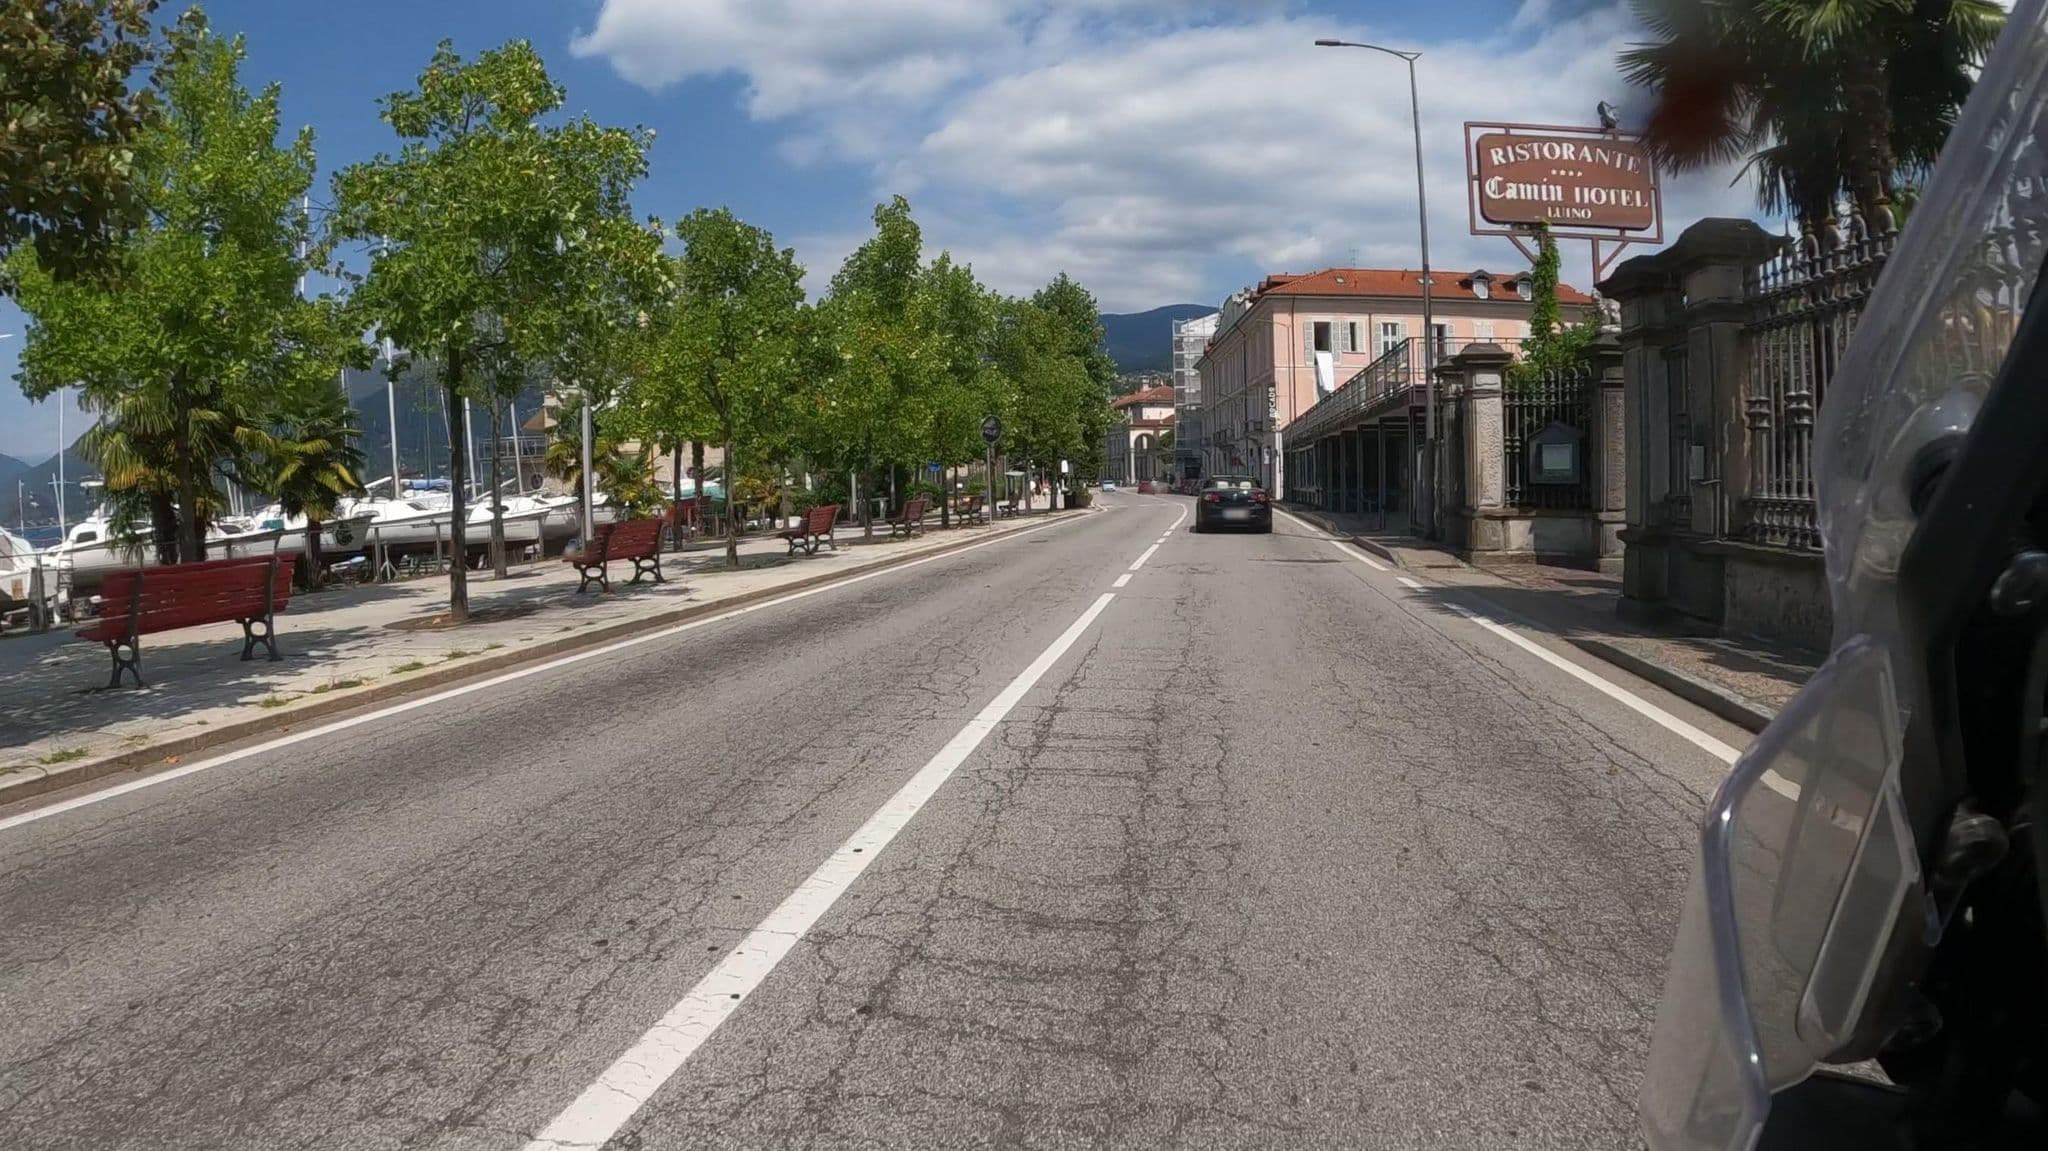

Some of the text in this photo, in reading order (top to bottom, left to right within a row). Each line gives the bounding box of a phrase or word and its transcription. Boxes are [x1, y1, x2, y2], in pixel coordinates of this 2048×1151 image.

[1490, 142, 1642, 175] RISTORANTE
[1485, 175, 1649, 208] Camin HOTEL
[1547, 206, 1592, 220] LUINO
